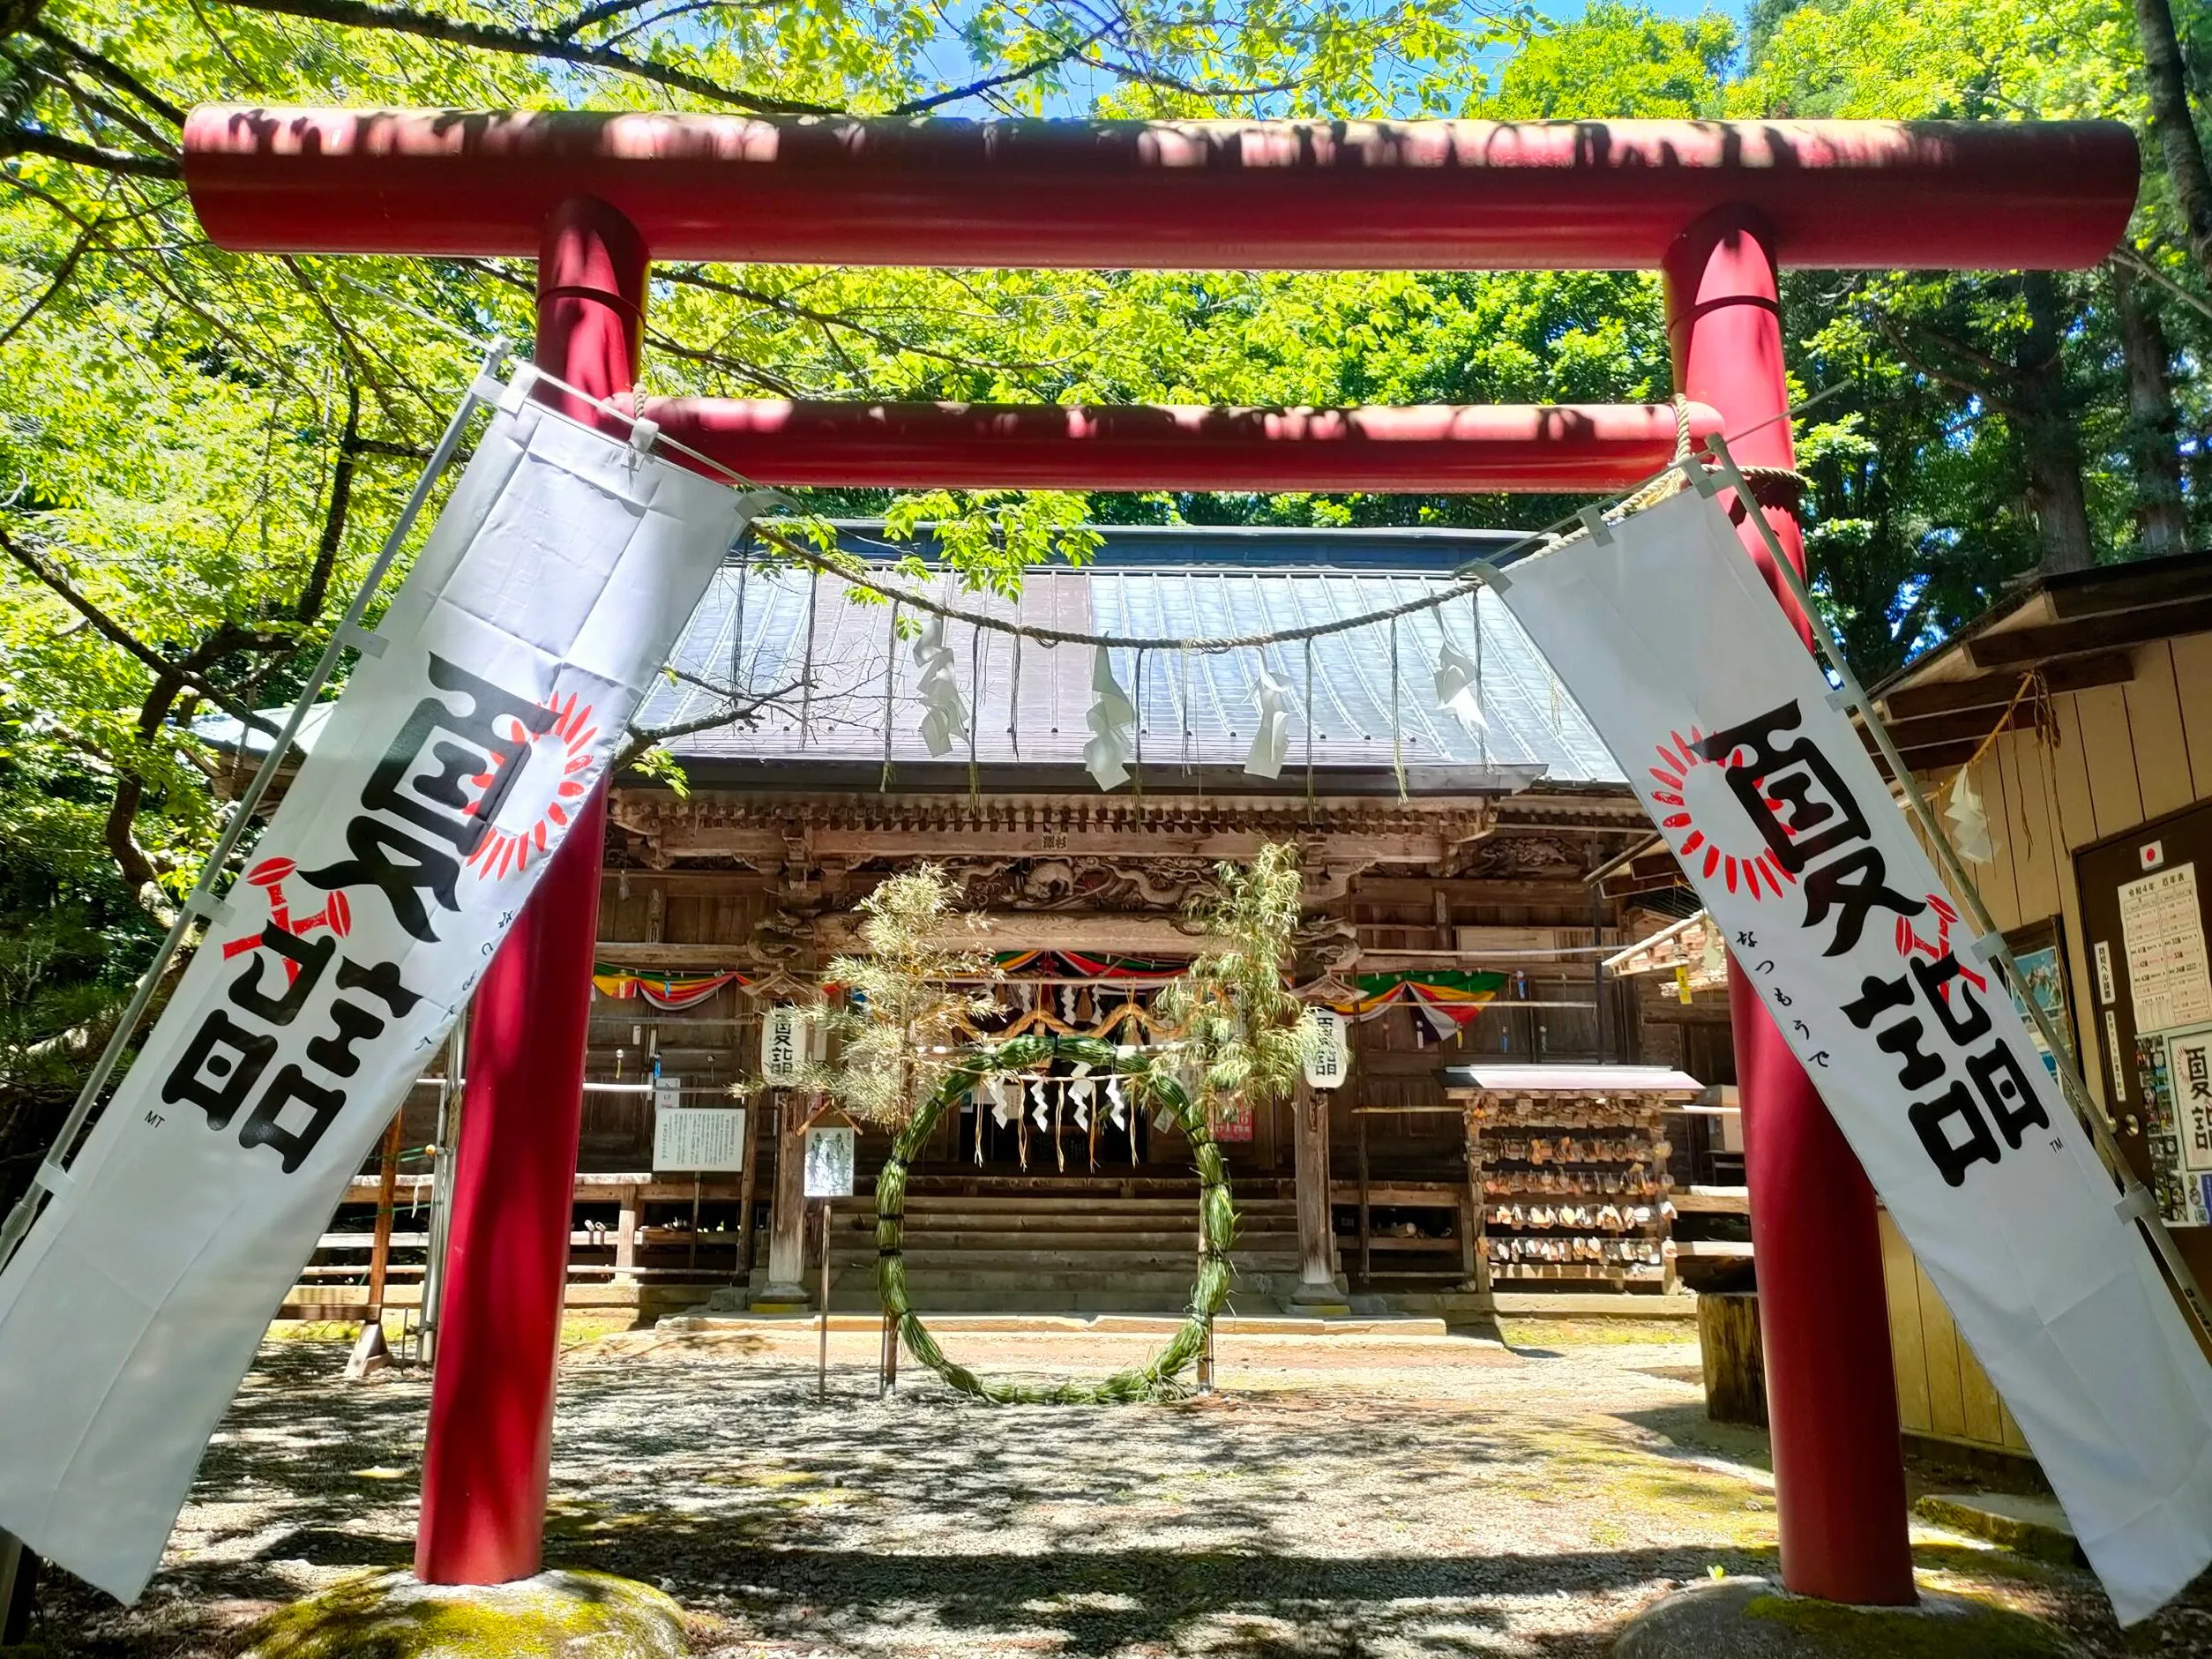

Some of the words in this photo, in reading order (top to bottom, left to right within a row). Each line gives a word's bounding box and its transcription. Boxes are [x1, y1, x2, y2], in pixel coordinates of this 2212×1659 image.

[1686, 698, 2050, 1186] 夏詣
[1736, 930, 1830, 1068] なつもうで
[2049, 1136, 2064, 1155] TM
